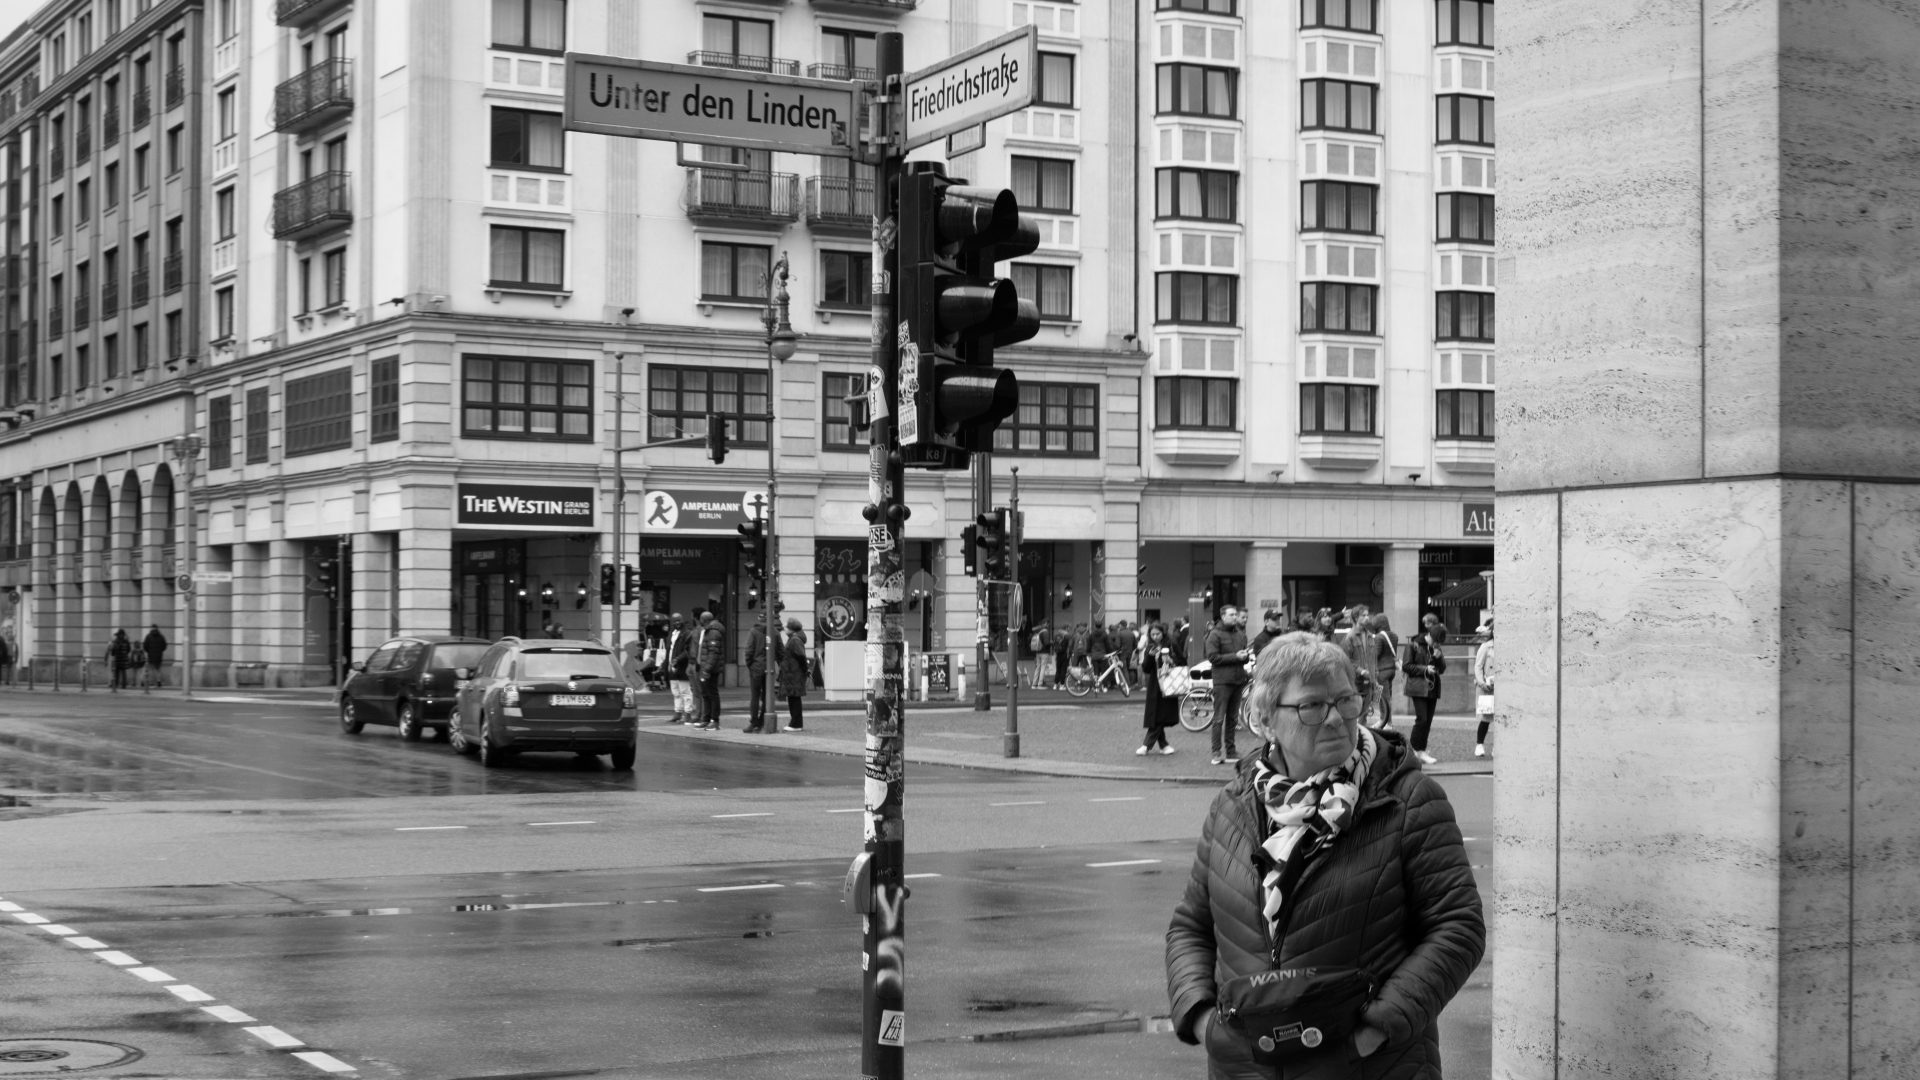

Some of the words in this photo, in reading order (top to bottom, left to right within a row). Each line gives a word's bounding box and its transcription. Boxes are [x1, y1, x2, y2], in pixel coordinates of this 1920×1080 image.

[911, 54, 1019, 122] Friedrichstraße
[589, 72, 671, 114] Unter
[683, 83, 734, 120] den
[747, 89, 837, 130] Linden
[497, 496, 562, 515] WESTIN
[564, 501, 590, 509] GRAND
[698, 512, 722, 520] BERLIN
